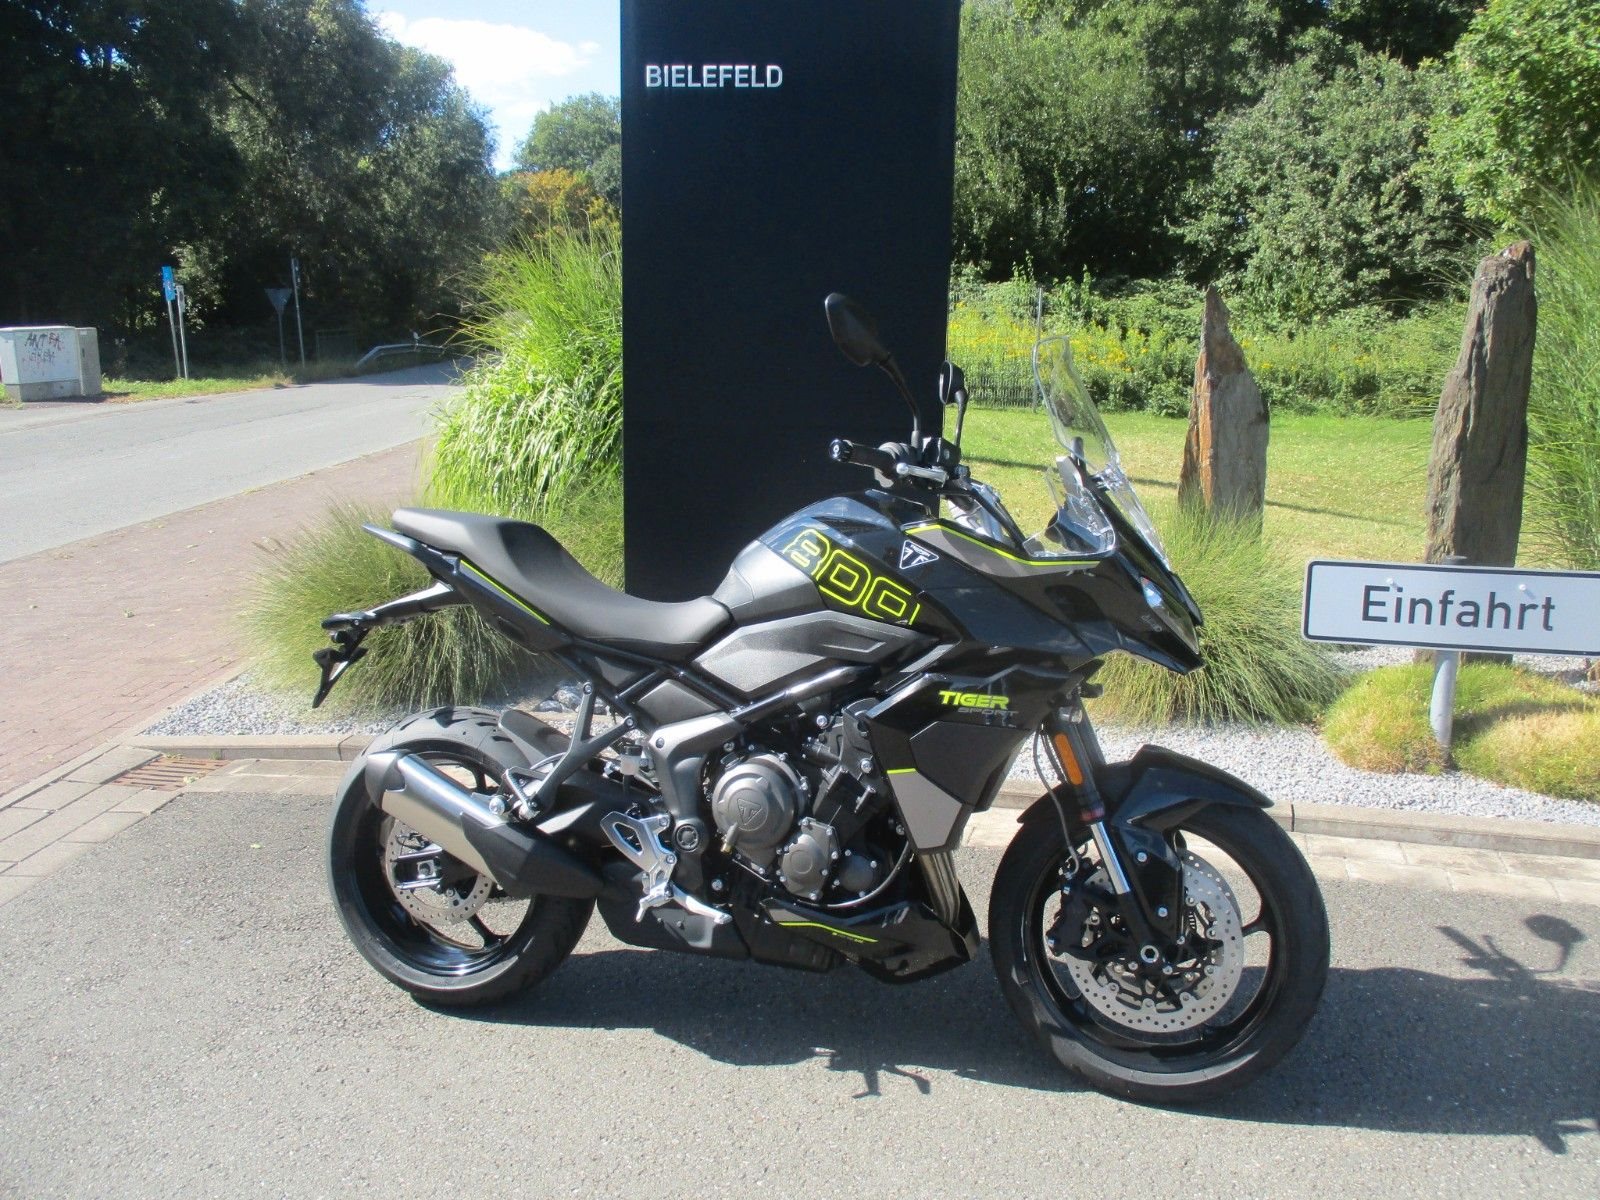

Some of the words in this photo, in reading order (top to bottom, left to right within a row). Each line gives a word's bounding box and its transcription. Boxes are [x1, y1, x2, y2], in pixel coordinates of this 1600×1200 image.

[645, 64, 783, 88] BIELEFELD
[1362, 584, 1556, 632] Einfahrt
[938, 689, 1009, 710] TIGER
